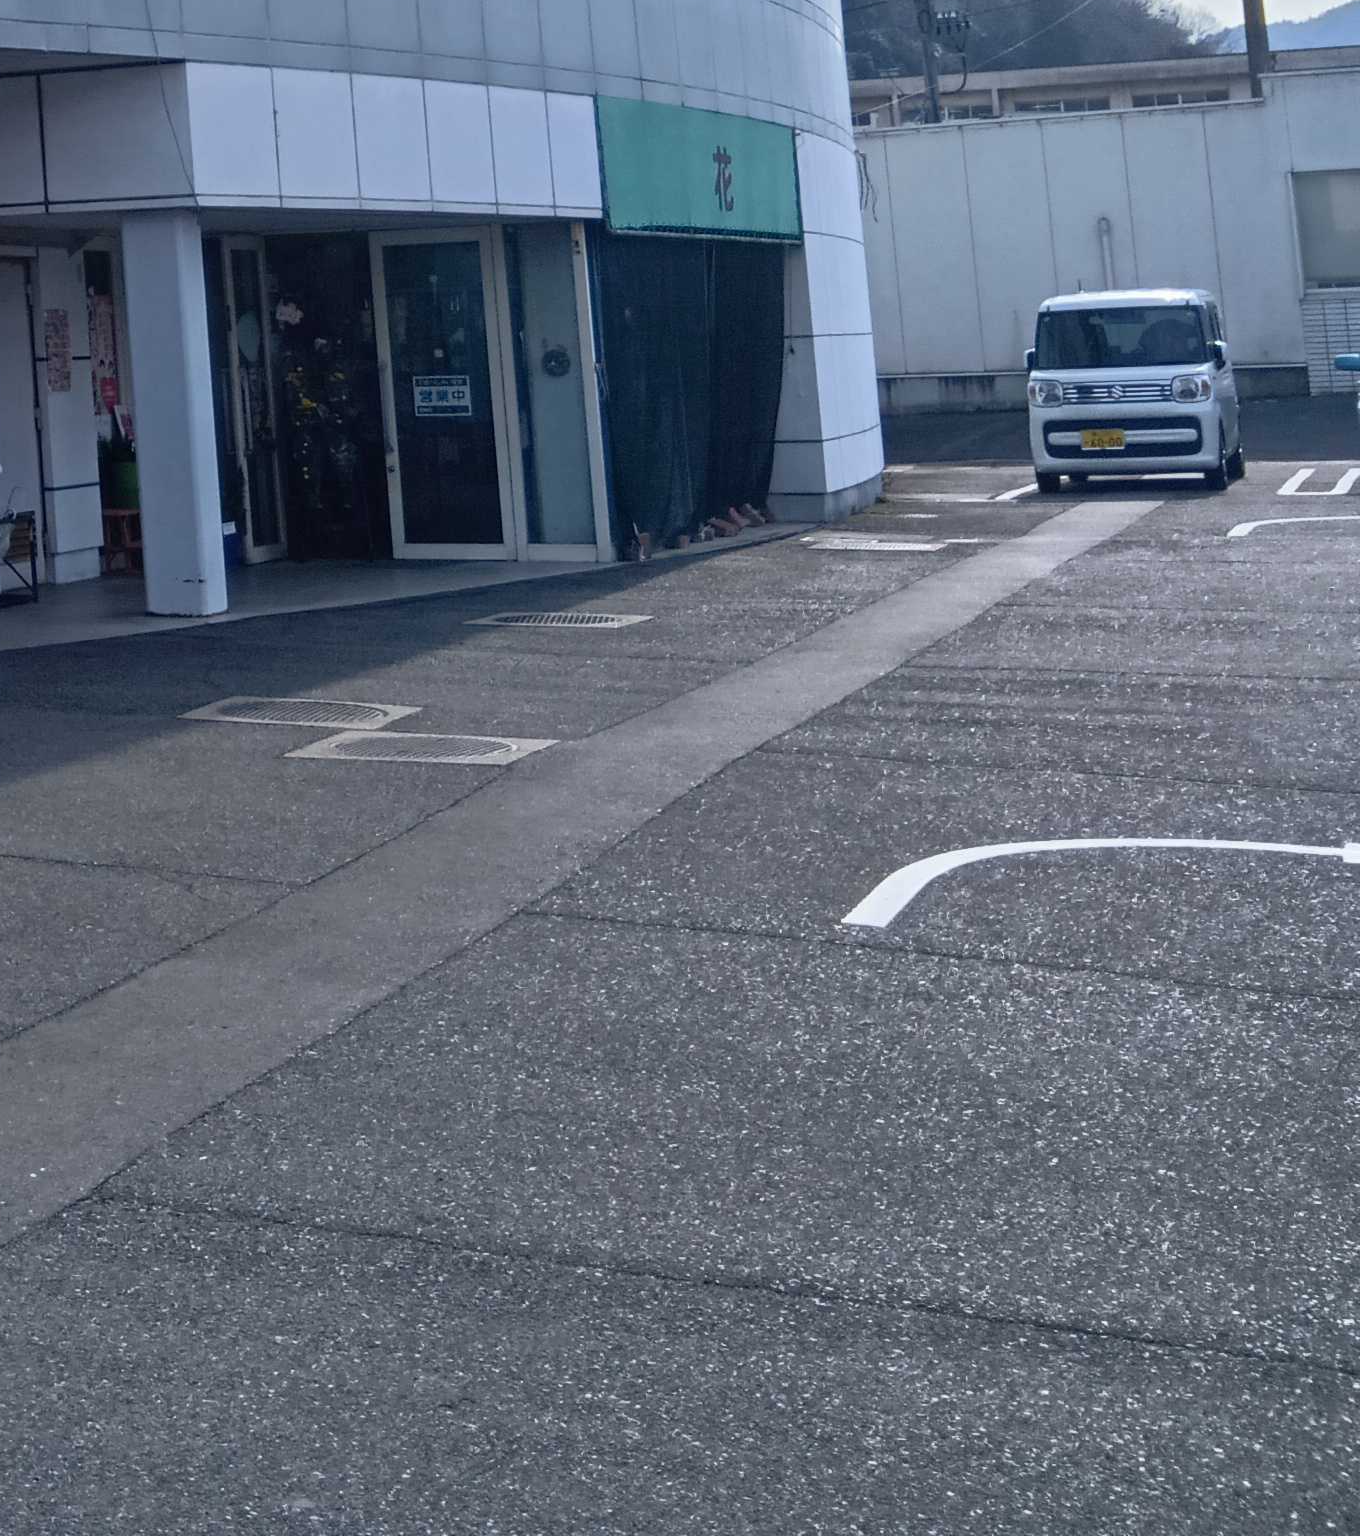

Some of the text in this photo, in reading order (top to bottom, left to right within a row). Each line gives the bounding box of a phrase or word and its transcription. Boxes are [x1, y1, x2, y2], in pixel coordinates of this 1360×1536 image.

[712, 144, 735, 213] 花
[418, 388, 465, 403] 営業中
